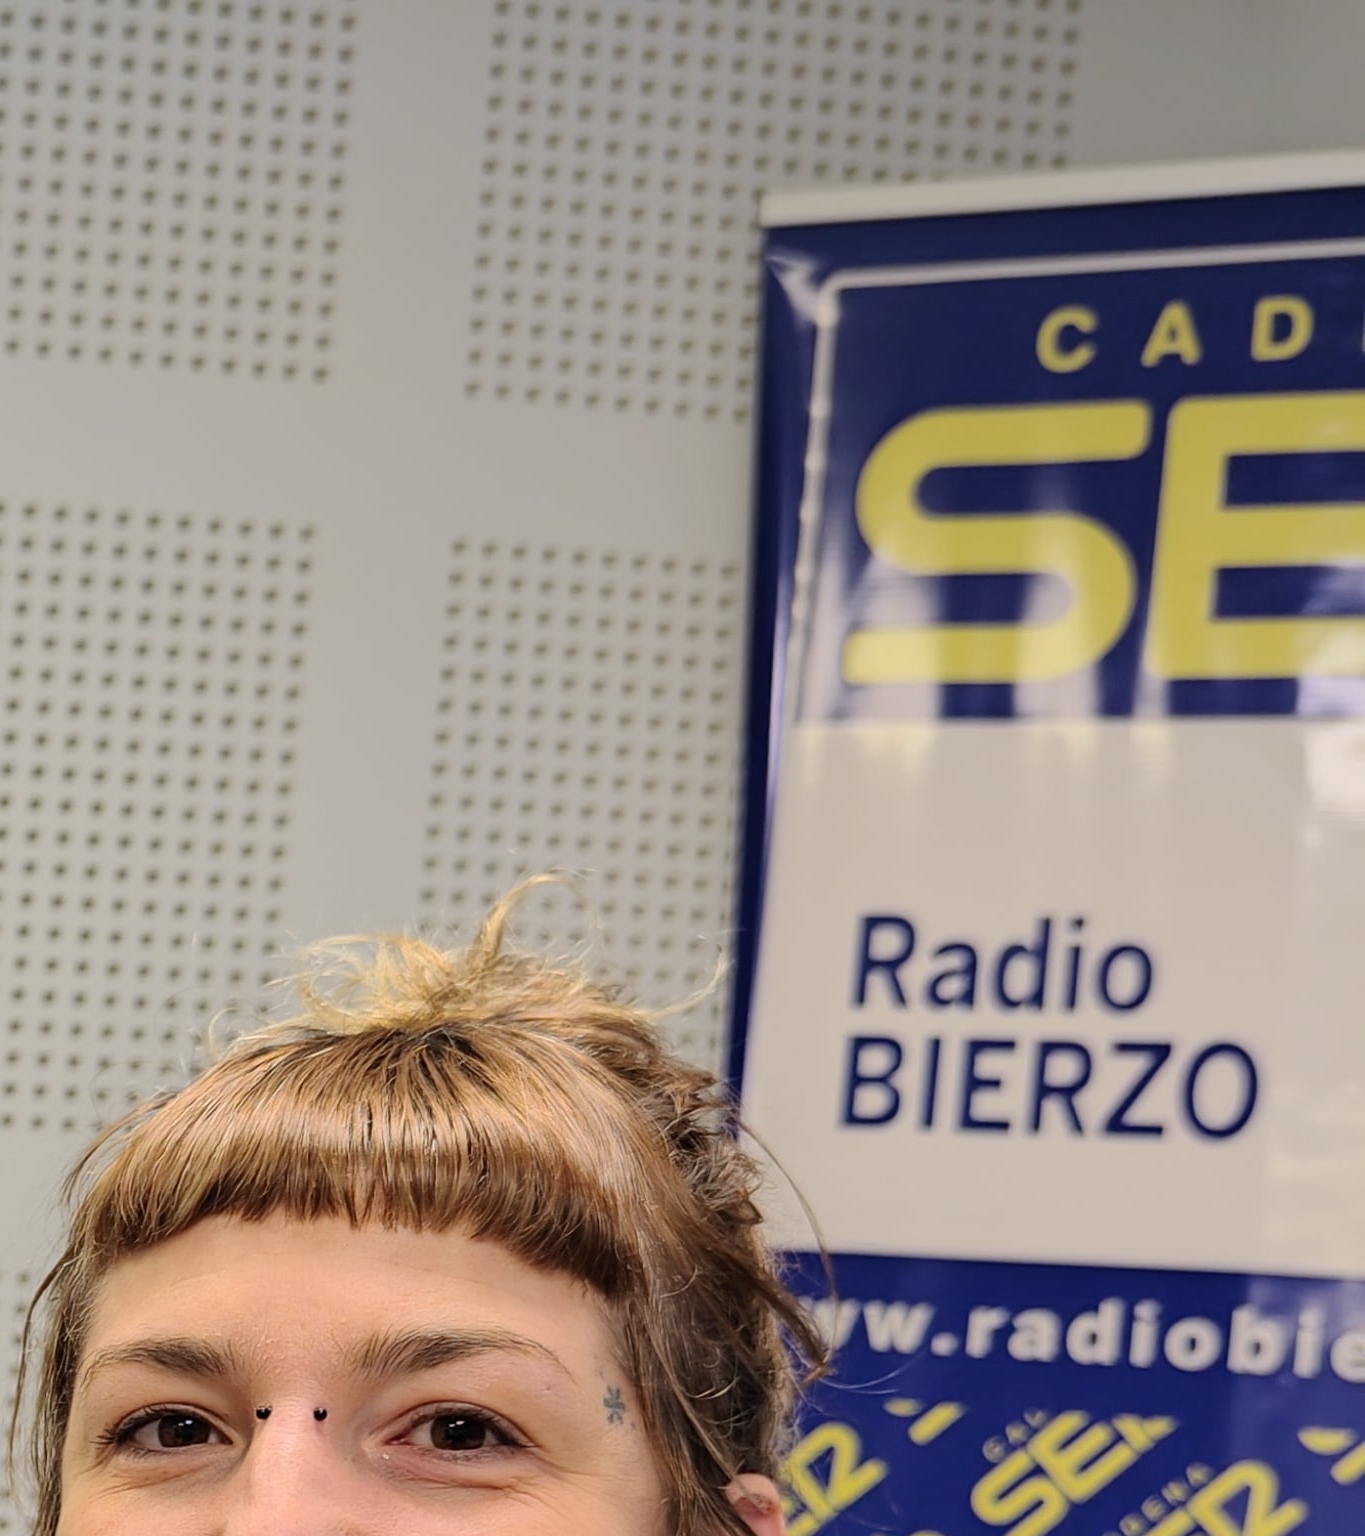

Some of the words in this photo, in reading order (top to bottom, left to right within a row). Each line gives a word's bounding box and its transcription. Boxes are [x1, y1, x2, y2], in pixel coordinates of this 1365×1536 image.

[1036, 294, 1365, 373] CAD
[851, 914, 1155, 1013] Radio
[839, 1034, 1260, 1143] BIERZO
